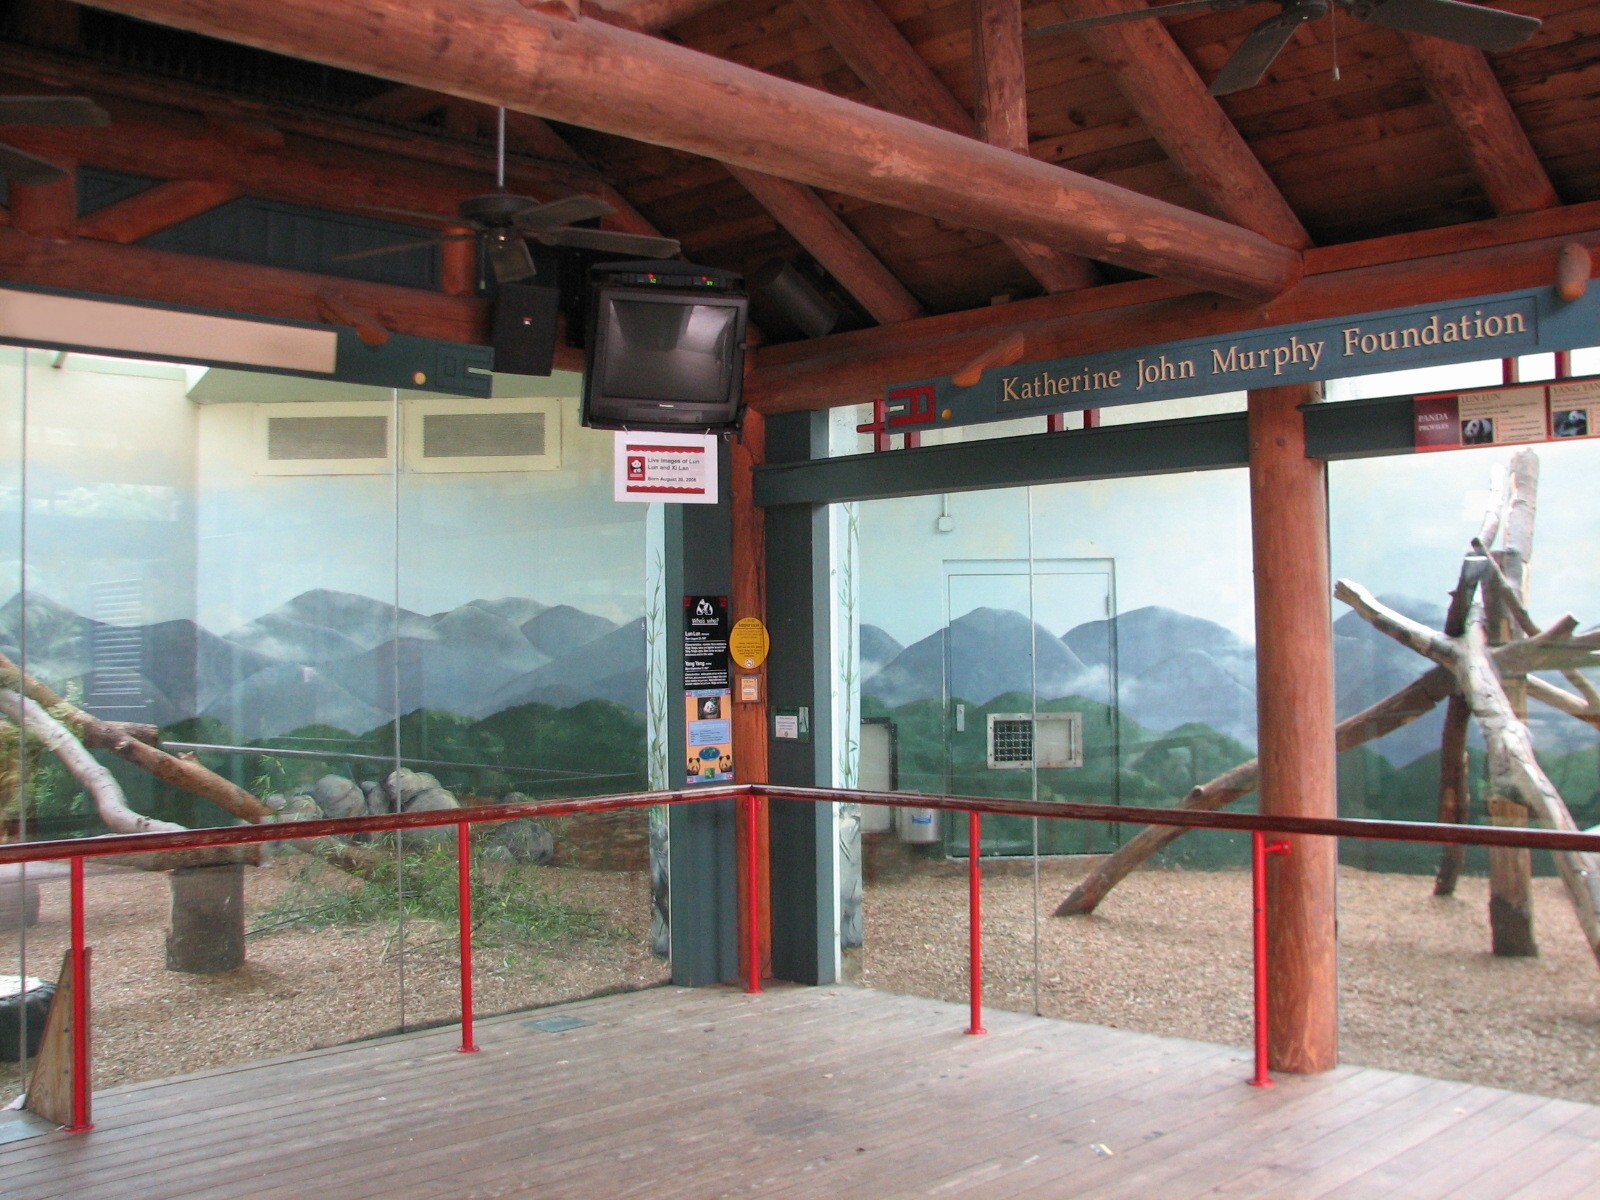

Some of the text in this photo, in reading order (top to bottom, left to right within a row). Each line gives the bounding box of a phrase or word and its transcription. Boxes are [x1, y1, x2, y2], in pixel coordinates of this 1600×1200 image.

[1002, 310, 1527, 402] Katherine John Murphy Foundation
[1418, 413, 1449, 422] PANDA
